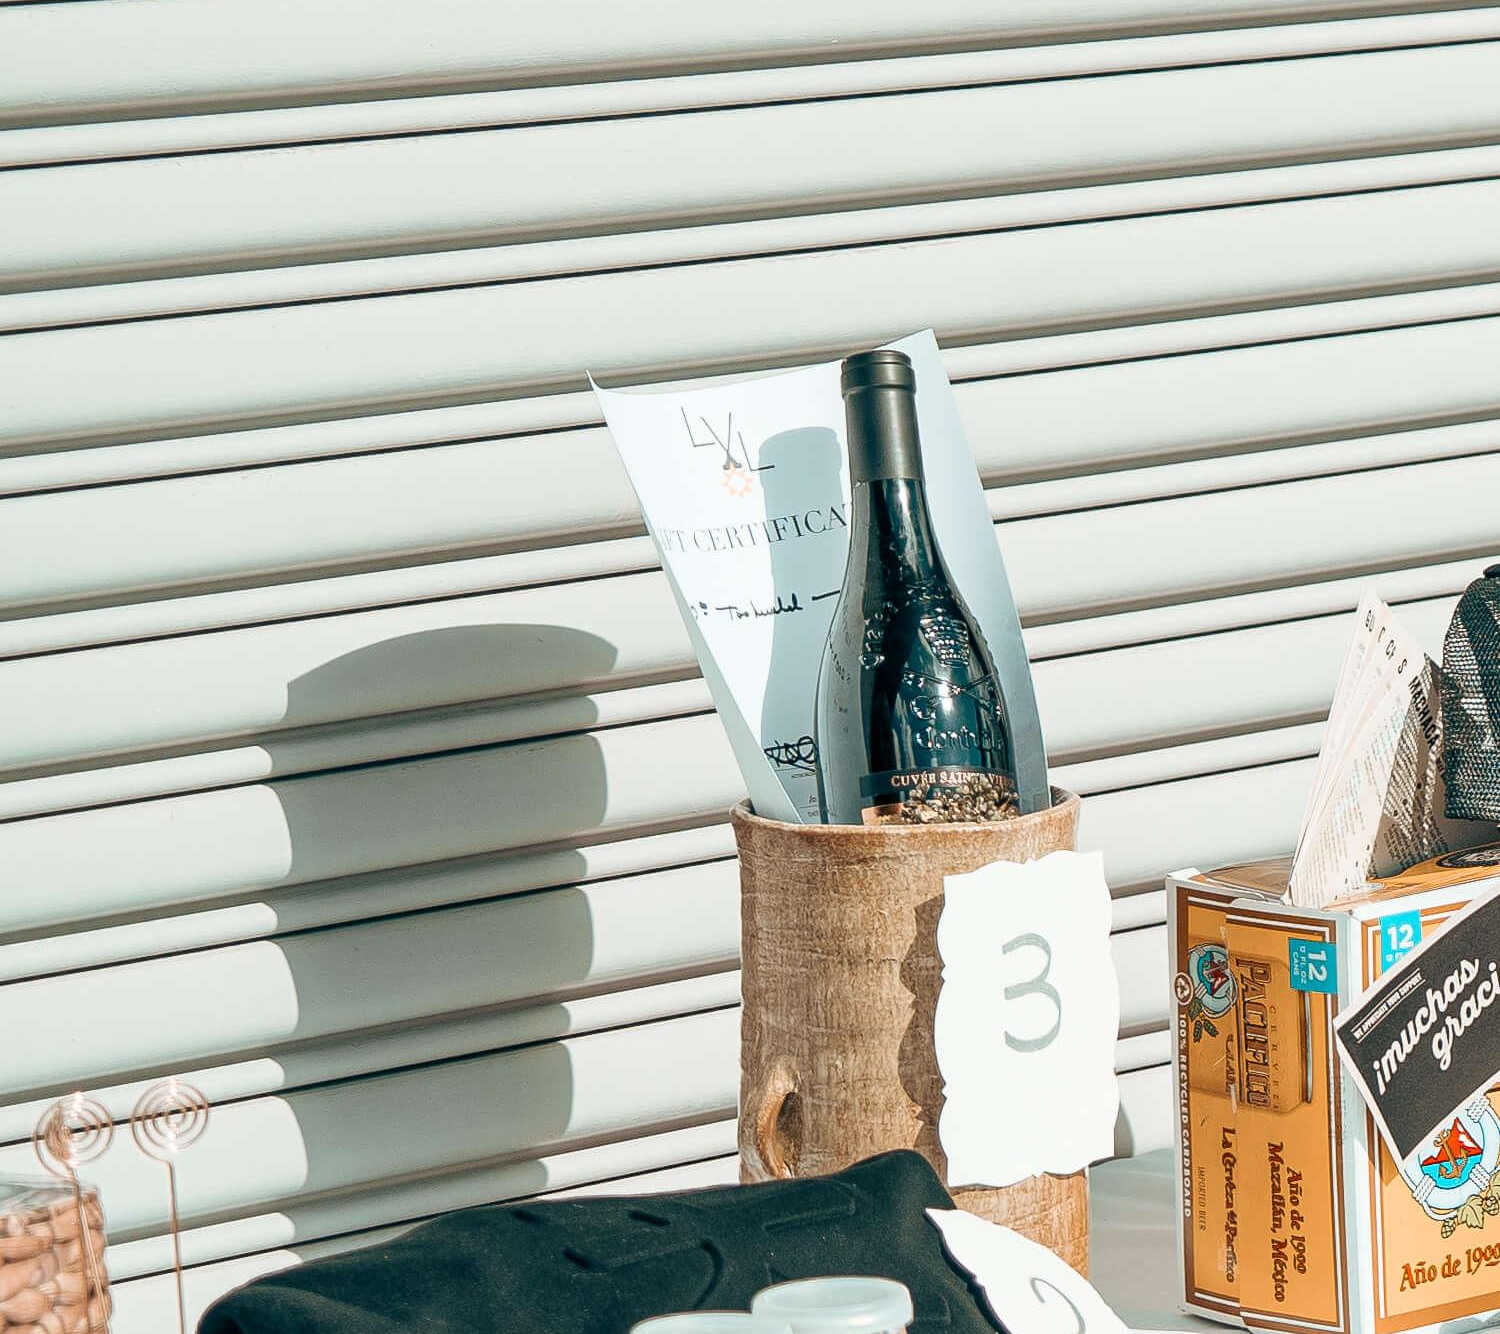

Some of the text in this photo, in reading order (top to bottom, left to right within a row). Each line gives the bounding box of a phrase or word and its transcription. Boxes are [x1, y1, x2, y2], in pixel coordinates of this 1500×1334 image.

[692, 503, 848, 553] CERTIFICA
[1308, 950, 1328, 982] 12
[1387, 923, 1416, 951] 12
[1000, 931, 1063, 1054] 3
[1235, 957, 1272, 1107] PACIFICO
[1374, 958, 1480, 1095] ¡muchas
[1179, 1013, 1192, 1218] 100% RECYCLED CARDBOARD
[1221, 1126, 1237, 1149] La
[1286, 1167, 1307, 1275] Año de 1900
[1271, 1238, 1289, 1303] México
[1400, 1261, 1438, 1292] Año
[1441, 1254, 1462, 1279] de
